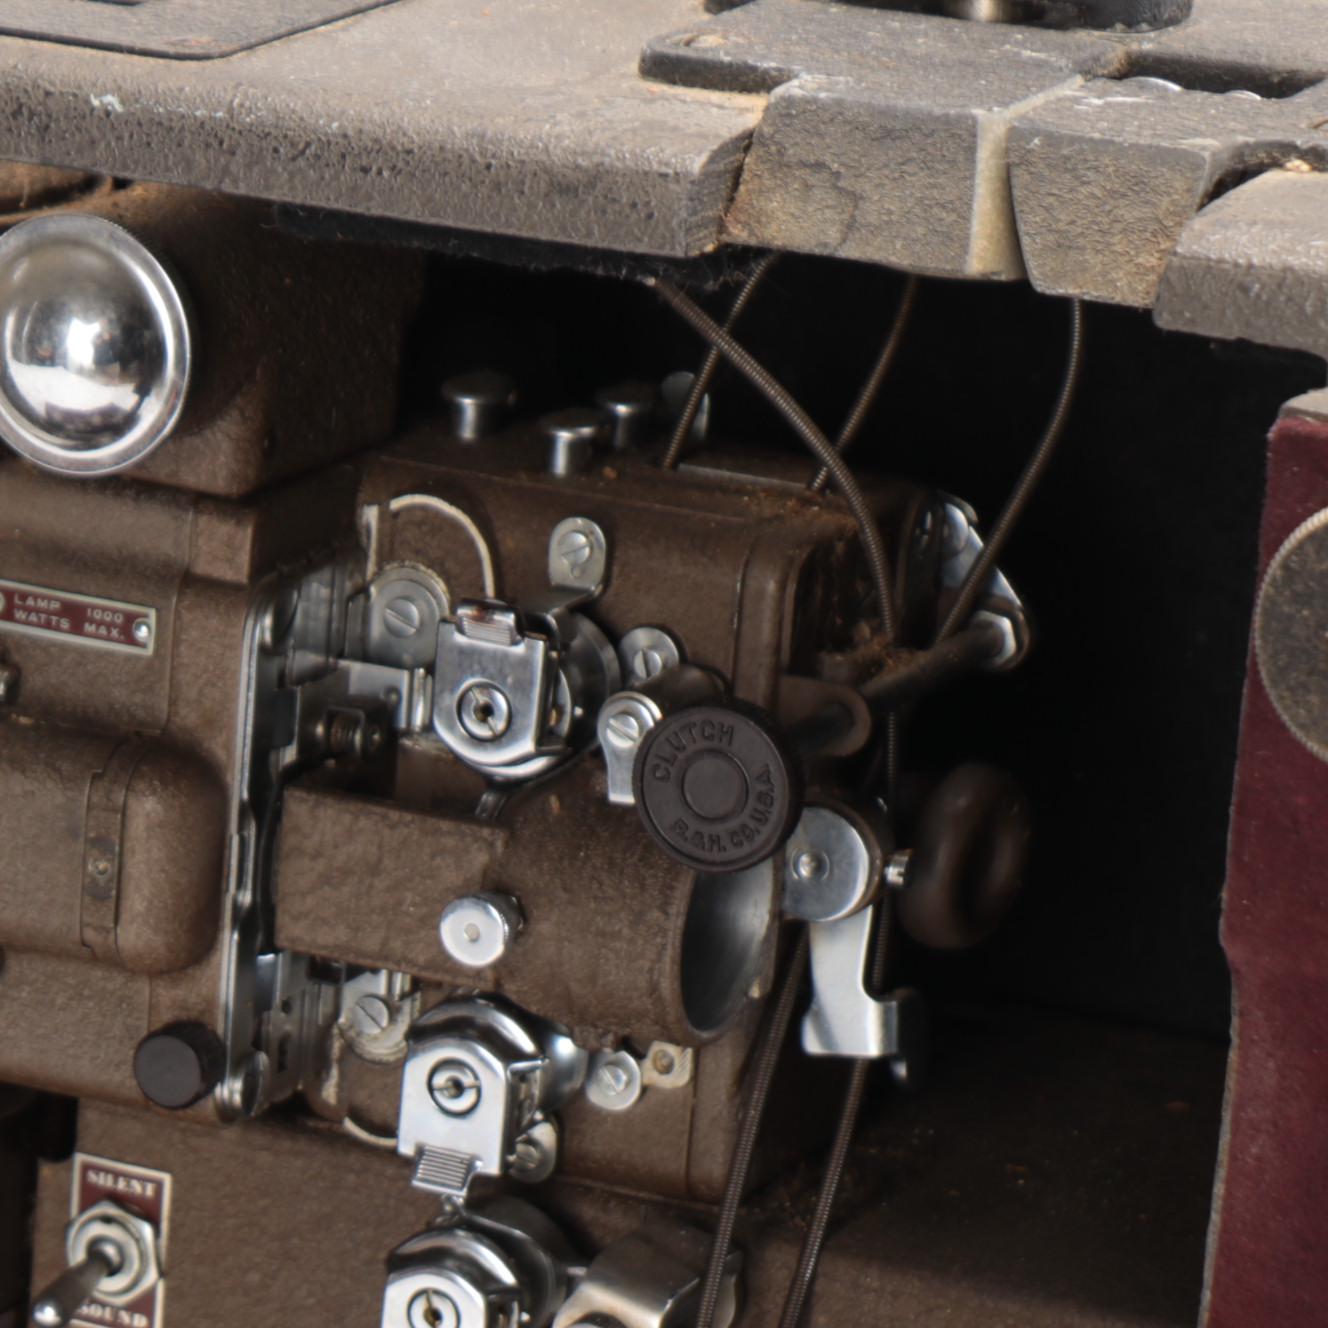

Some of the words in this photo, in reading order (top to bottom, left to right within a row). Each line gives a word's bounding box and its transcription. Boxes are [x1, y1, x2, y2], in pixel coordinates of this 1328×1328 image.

[13, 593, 62, 610] LAMP
[86, 607, 125, 624] 1000
[13, 609, 71, 629] WATTS
[83, 621, 125, 640] MAX.
[651, 719, 735, 783] CLUTCH
[86, 1169, 157, 1198] SILENT
